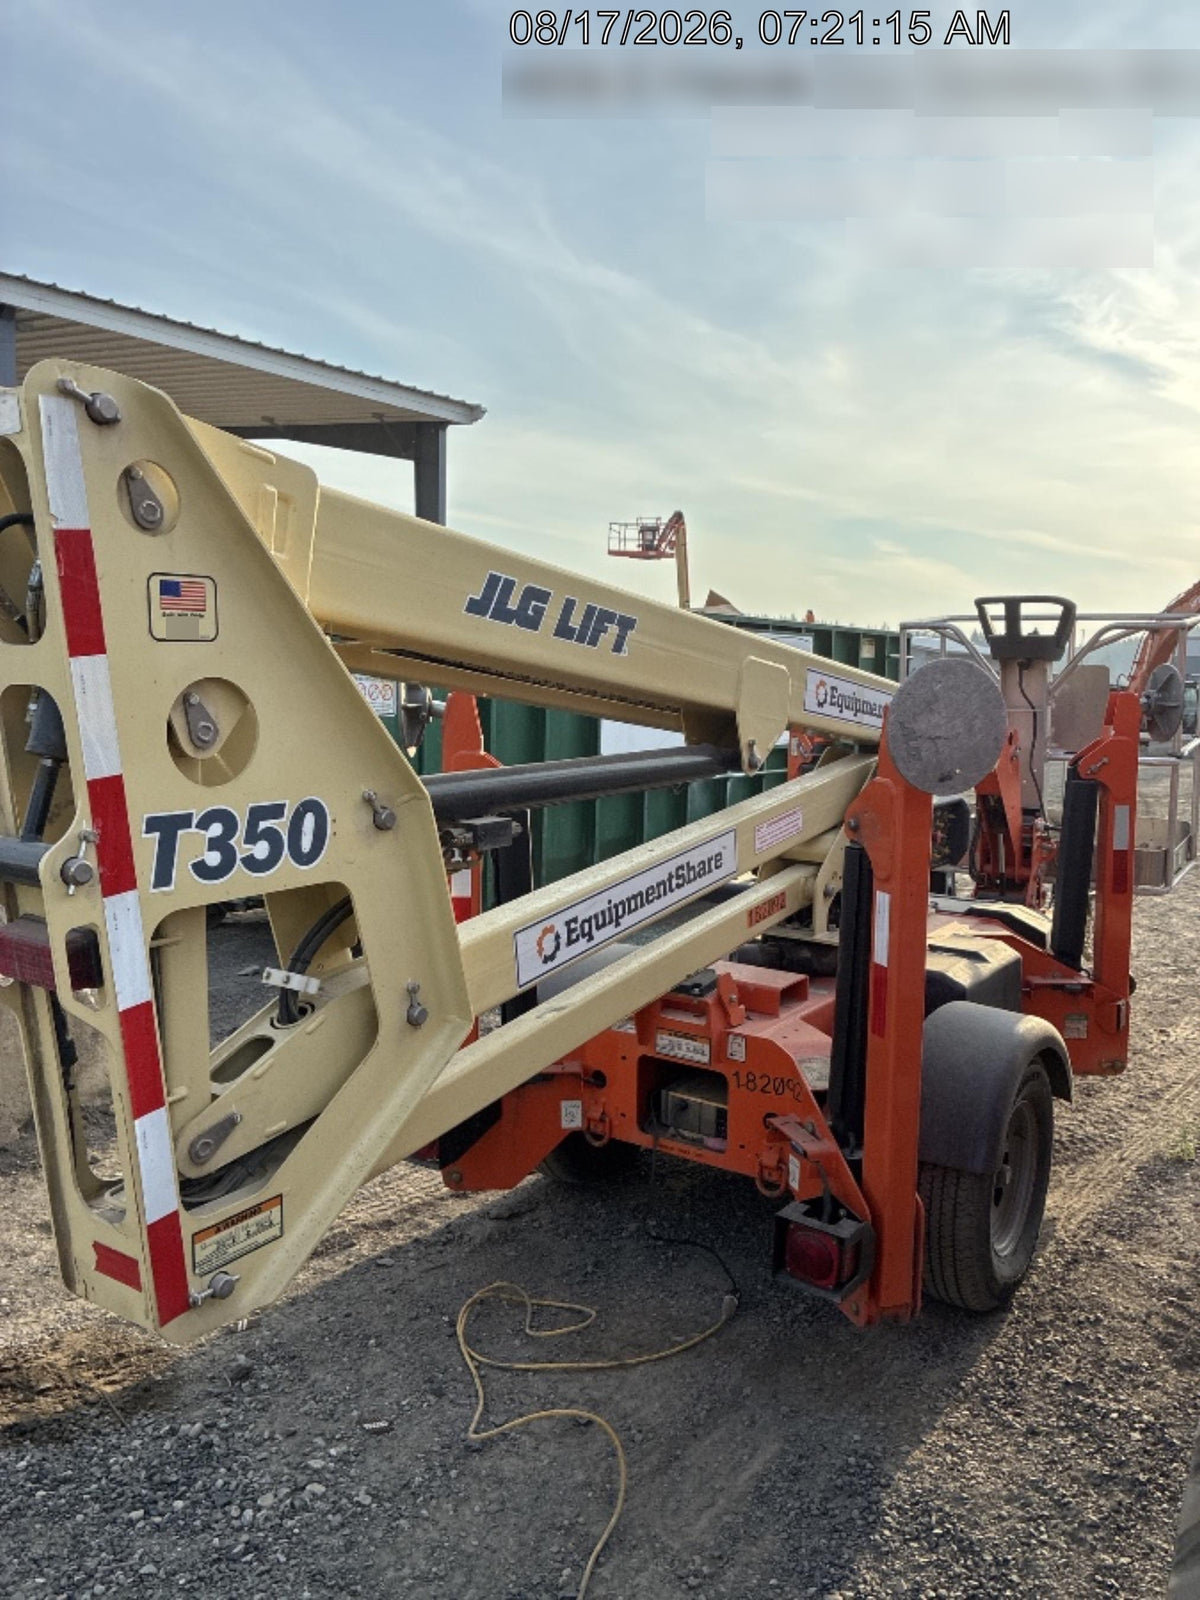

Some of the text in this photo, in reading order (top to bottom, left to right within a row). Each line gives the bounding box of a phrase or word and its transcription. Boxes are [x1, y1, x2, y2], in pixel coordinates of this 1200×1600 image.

[463, 570, 638, 656] JLG LIFT
[142, 796, 331, 893] T350
[565, 851, 724, 944] EquipmentShare
